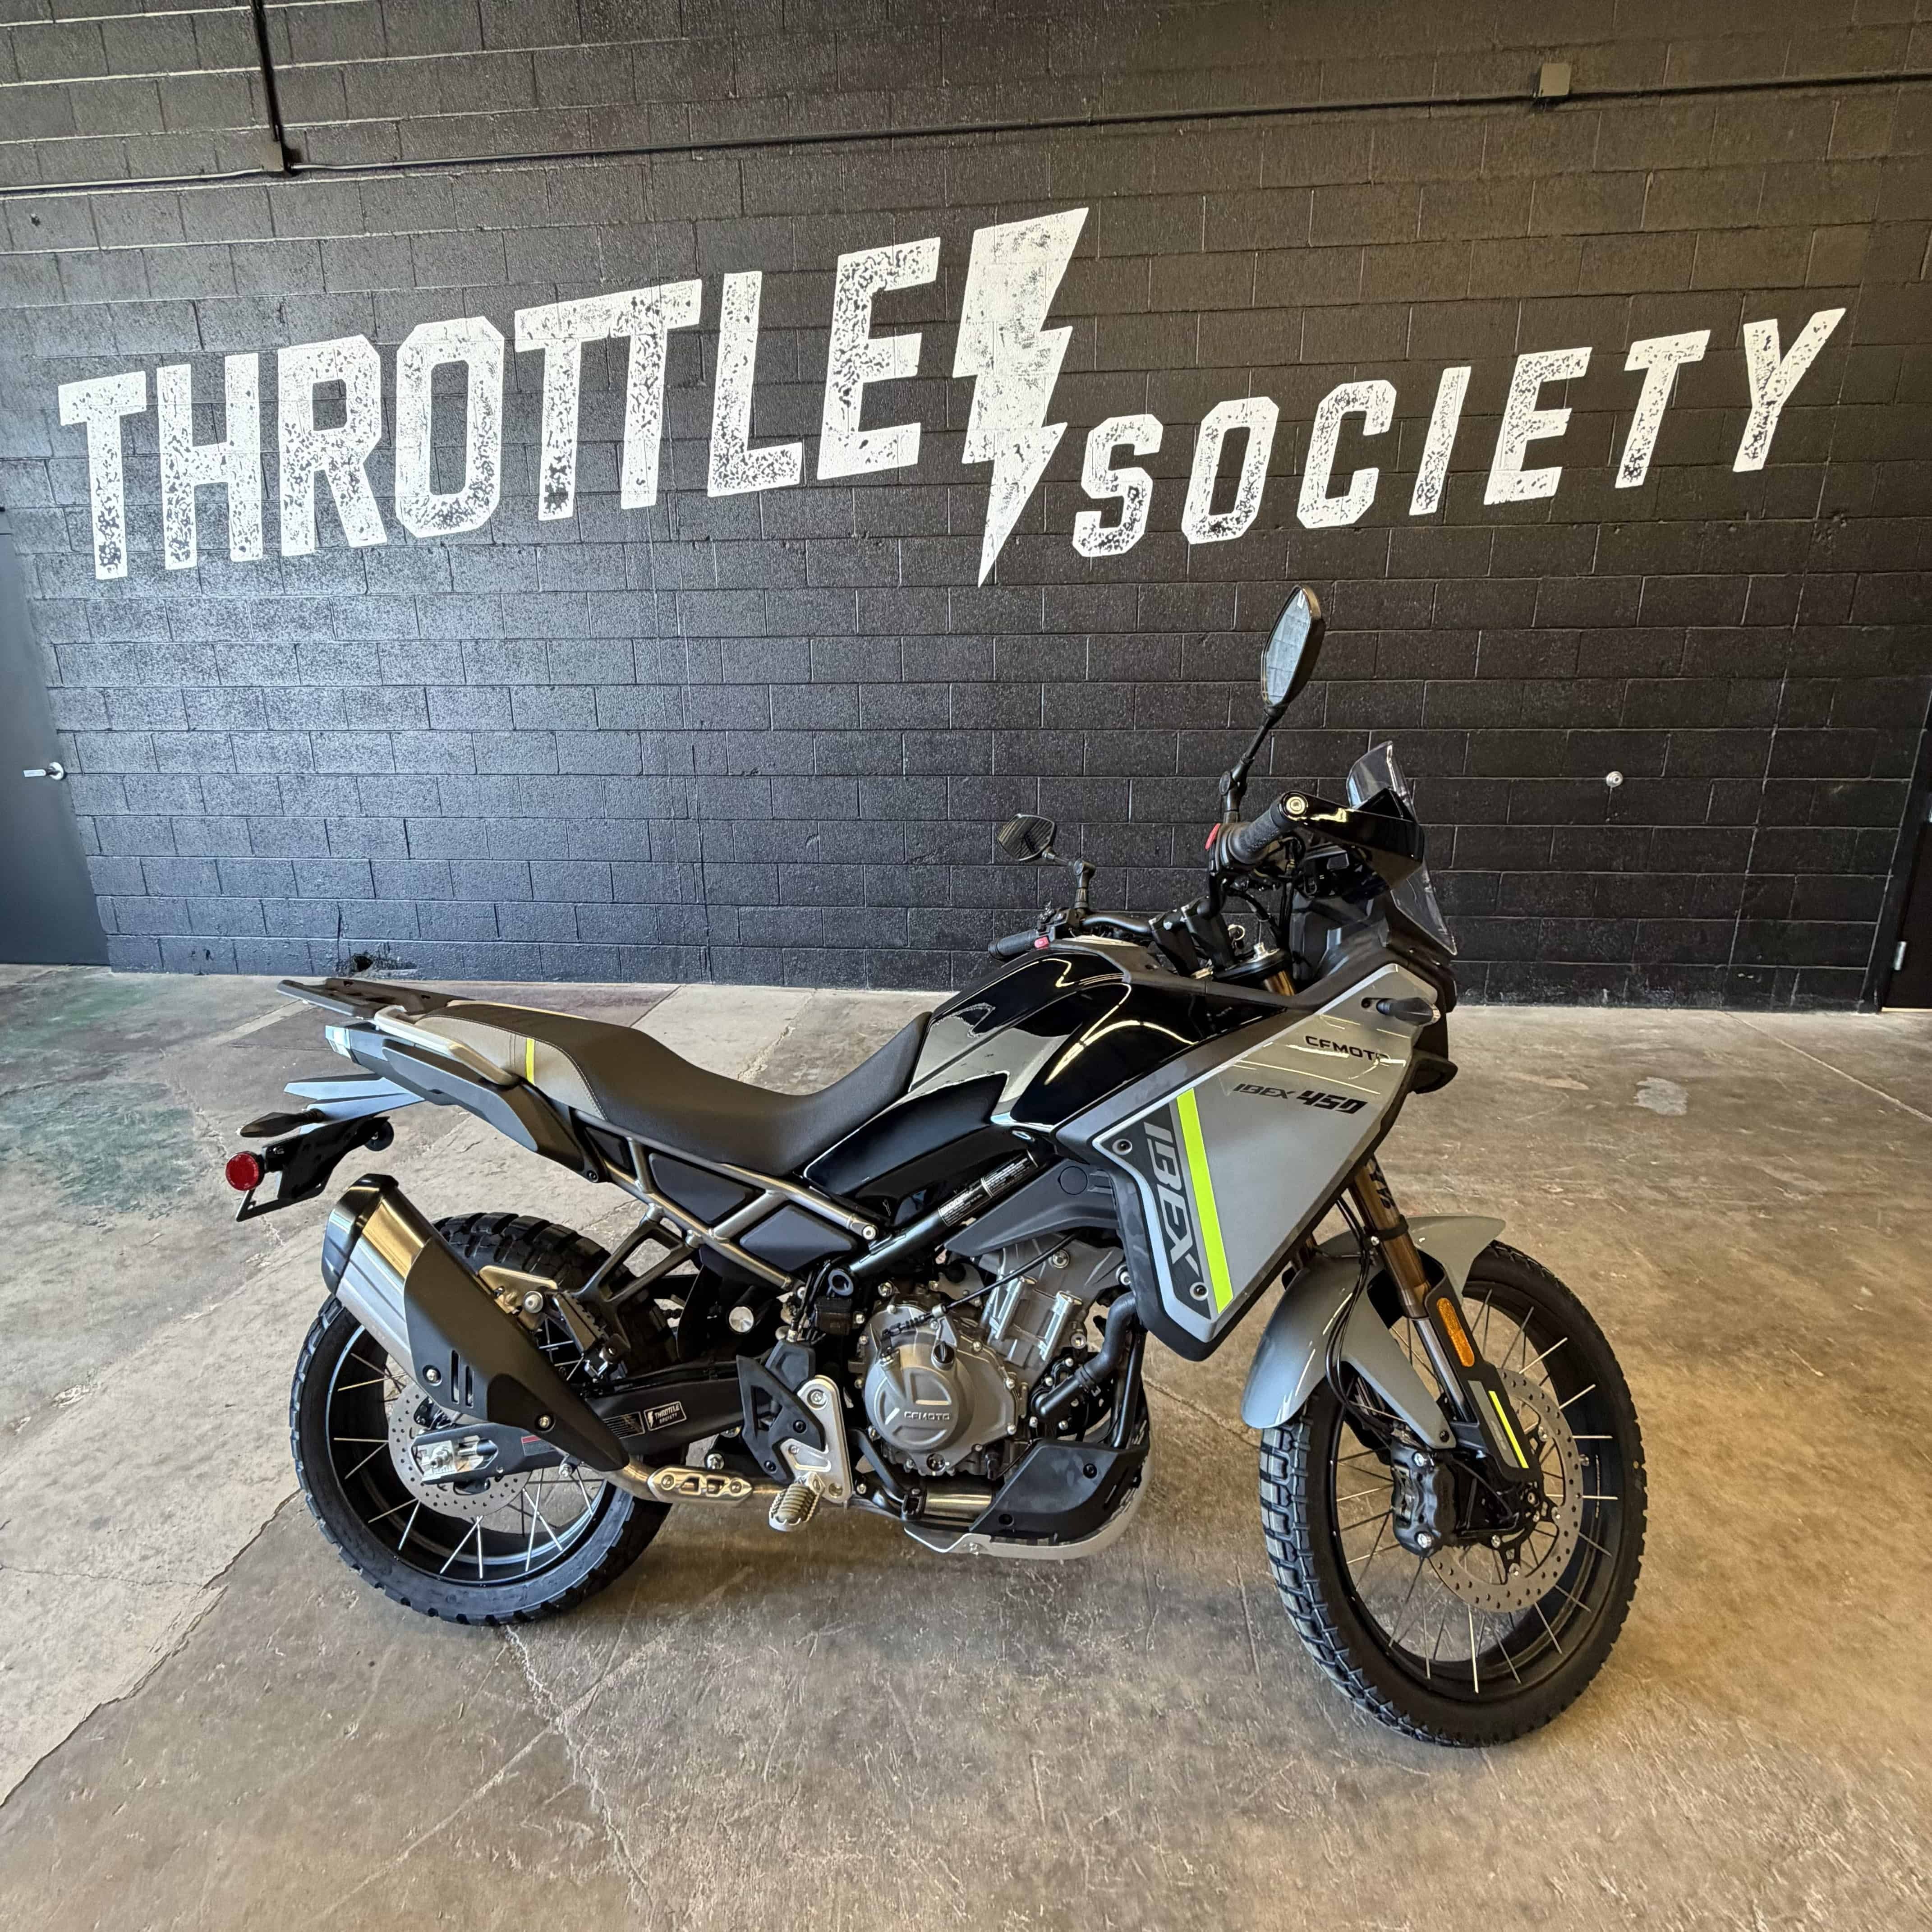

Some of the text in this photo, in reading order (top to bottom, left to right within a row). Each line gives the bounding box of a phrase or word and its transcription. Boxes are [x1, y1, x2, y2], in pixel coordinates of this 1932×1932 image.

[58, 237, 1846, 581] THROTTLE SOCIETY
[1233, 1083, 1368, 1114] IBEX 450
[1144, 1121, 1201, 1279] IBEX
[654, 1403, 680, 1420] THROTTLE
